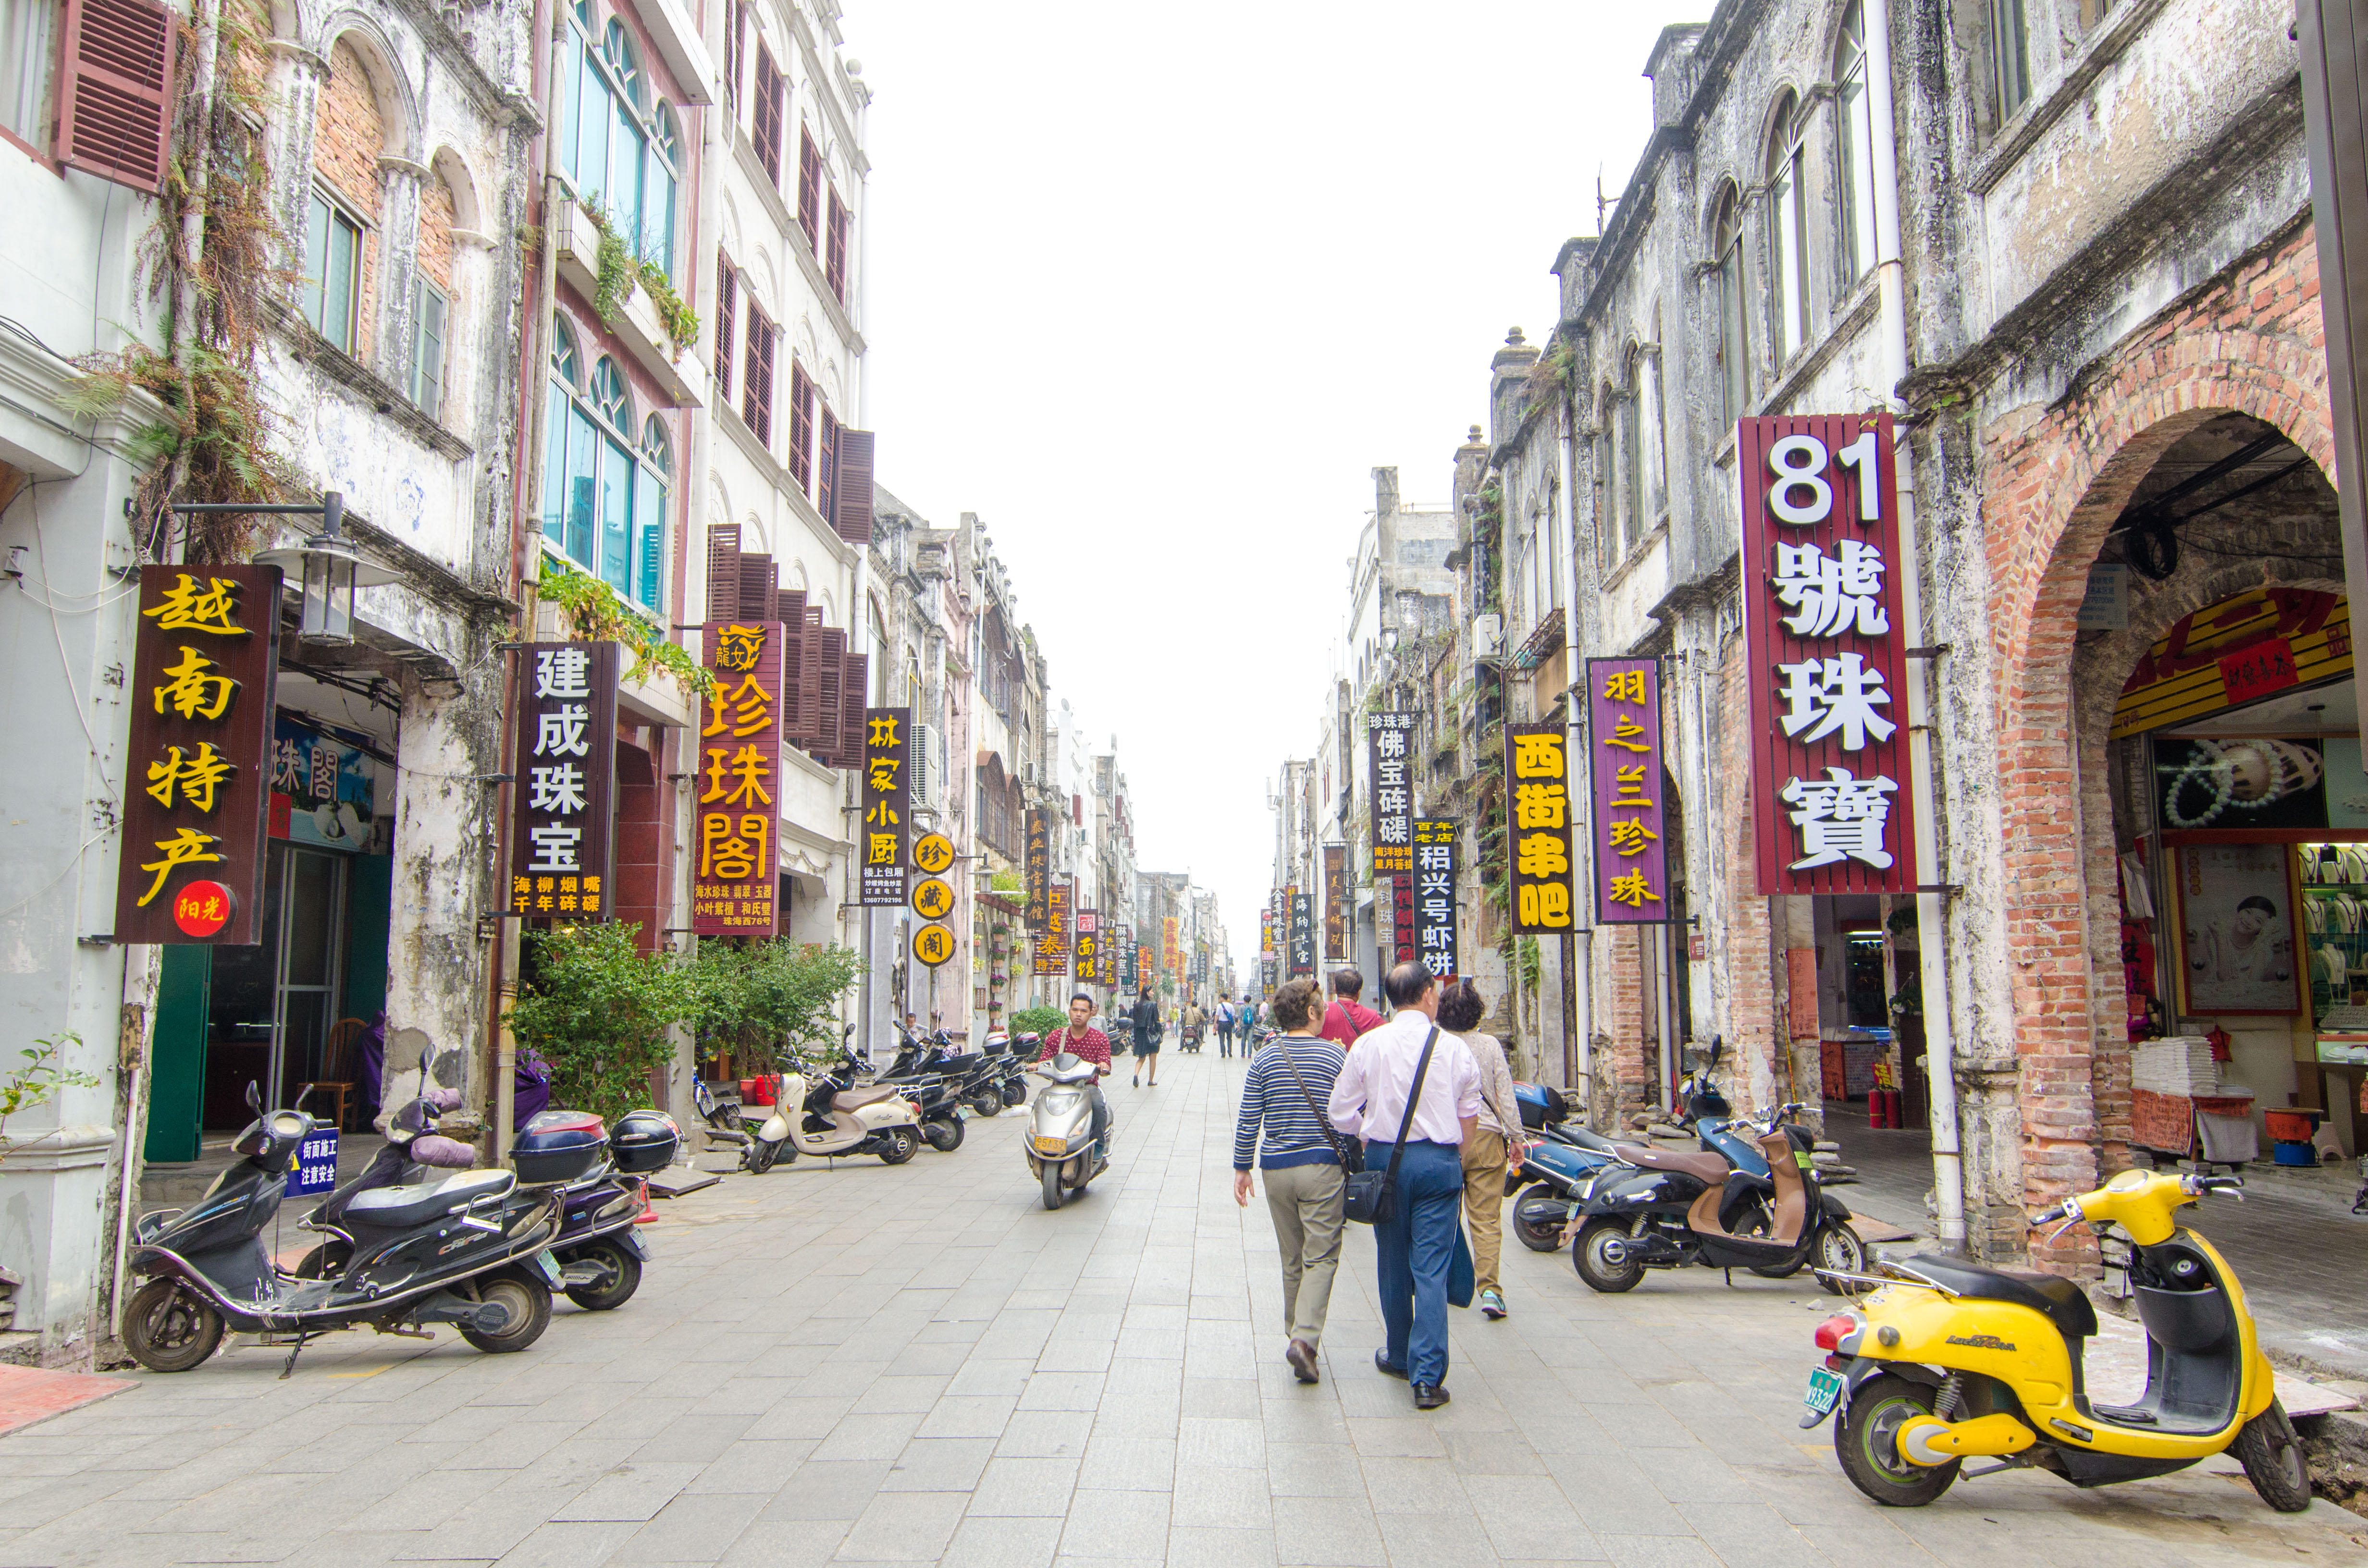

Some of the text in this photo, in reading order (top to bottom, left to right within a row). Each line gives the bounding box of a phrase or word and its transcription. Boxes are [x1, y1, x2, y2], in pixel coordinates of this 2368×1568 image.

[715, 646, 744, 666] 龍女
[1369, 714, 1411, 729] 珍珠港
[137, 573, 247, 907] 越南特产
[529, 647, 590, 871] 建成珠宝
[701, 674, 773, 879] 珍珠閣
[866, 714, 901, 864] 林家小厨
[1377, 730, 1408, 844] 佛宝砗磲
[1603, 671, 1661, 907] 羽之兰珍珠
[1414, 822, 1454, 831] 百年
[1514, 734, 1570, 928] 西街串吧
[1414, 833, 1454, 843] 老店
[1374, 847, 1412, 857] 南洋珍珠
[864, 867, 903, 877] 楼上包厢
[1374, 859, 1412, 870] 星月菩提
[514, 875, 600, 893] 海柳烟嘴
[695, 885, 772, 898] 海水珍珠 翡翠 玉器
[179, 897, 224, 921] 阳光
[514, 894, 600, 912] 千年砗磲
[695, 902, 771, 916] 小叶紫檀 和氏璧
[723, 917, 771, 926] 珠海西76号
[1036, 958, 1063, 971] 特产
[1077, 937, 1096, 977] 面馆
[1560, 1127, 1579, 1135] TAILG
[303, 1139, 336, 1159] 街面施工
[301, 1164, 335, 1185] 注意安全
